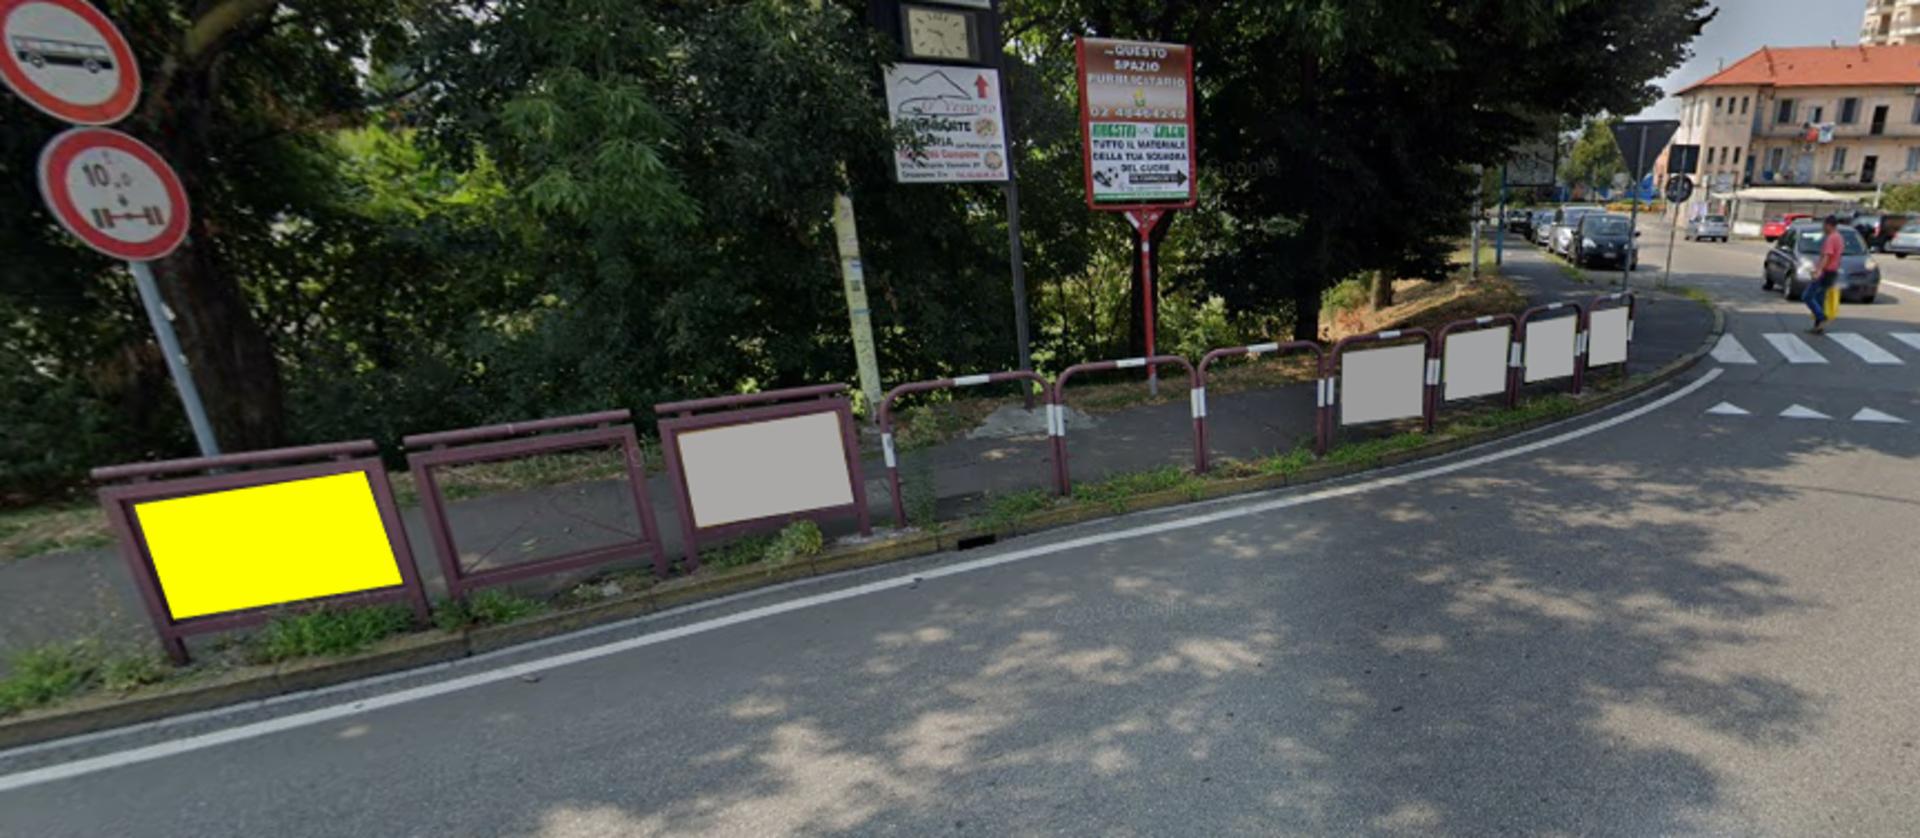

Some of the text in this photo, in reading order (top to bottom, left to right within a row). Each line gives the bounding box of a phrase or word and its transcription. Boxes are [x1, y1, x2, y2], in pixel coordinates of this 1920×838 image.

[1114, 60, 1160, 72] SPAZIO
[1093, 140, 1185, 150] TUTTO IL MATERIALE
[1093, 152, 1187, 161] DELLA TUA SQUADRA
[1121, 164, 1170, 172] DEL CUORE
